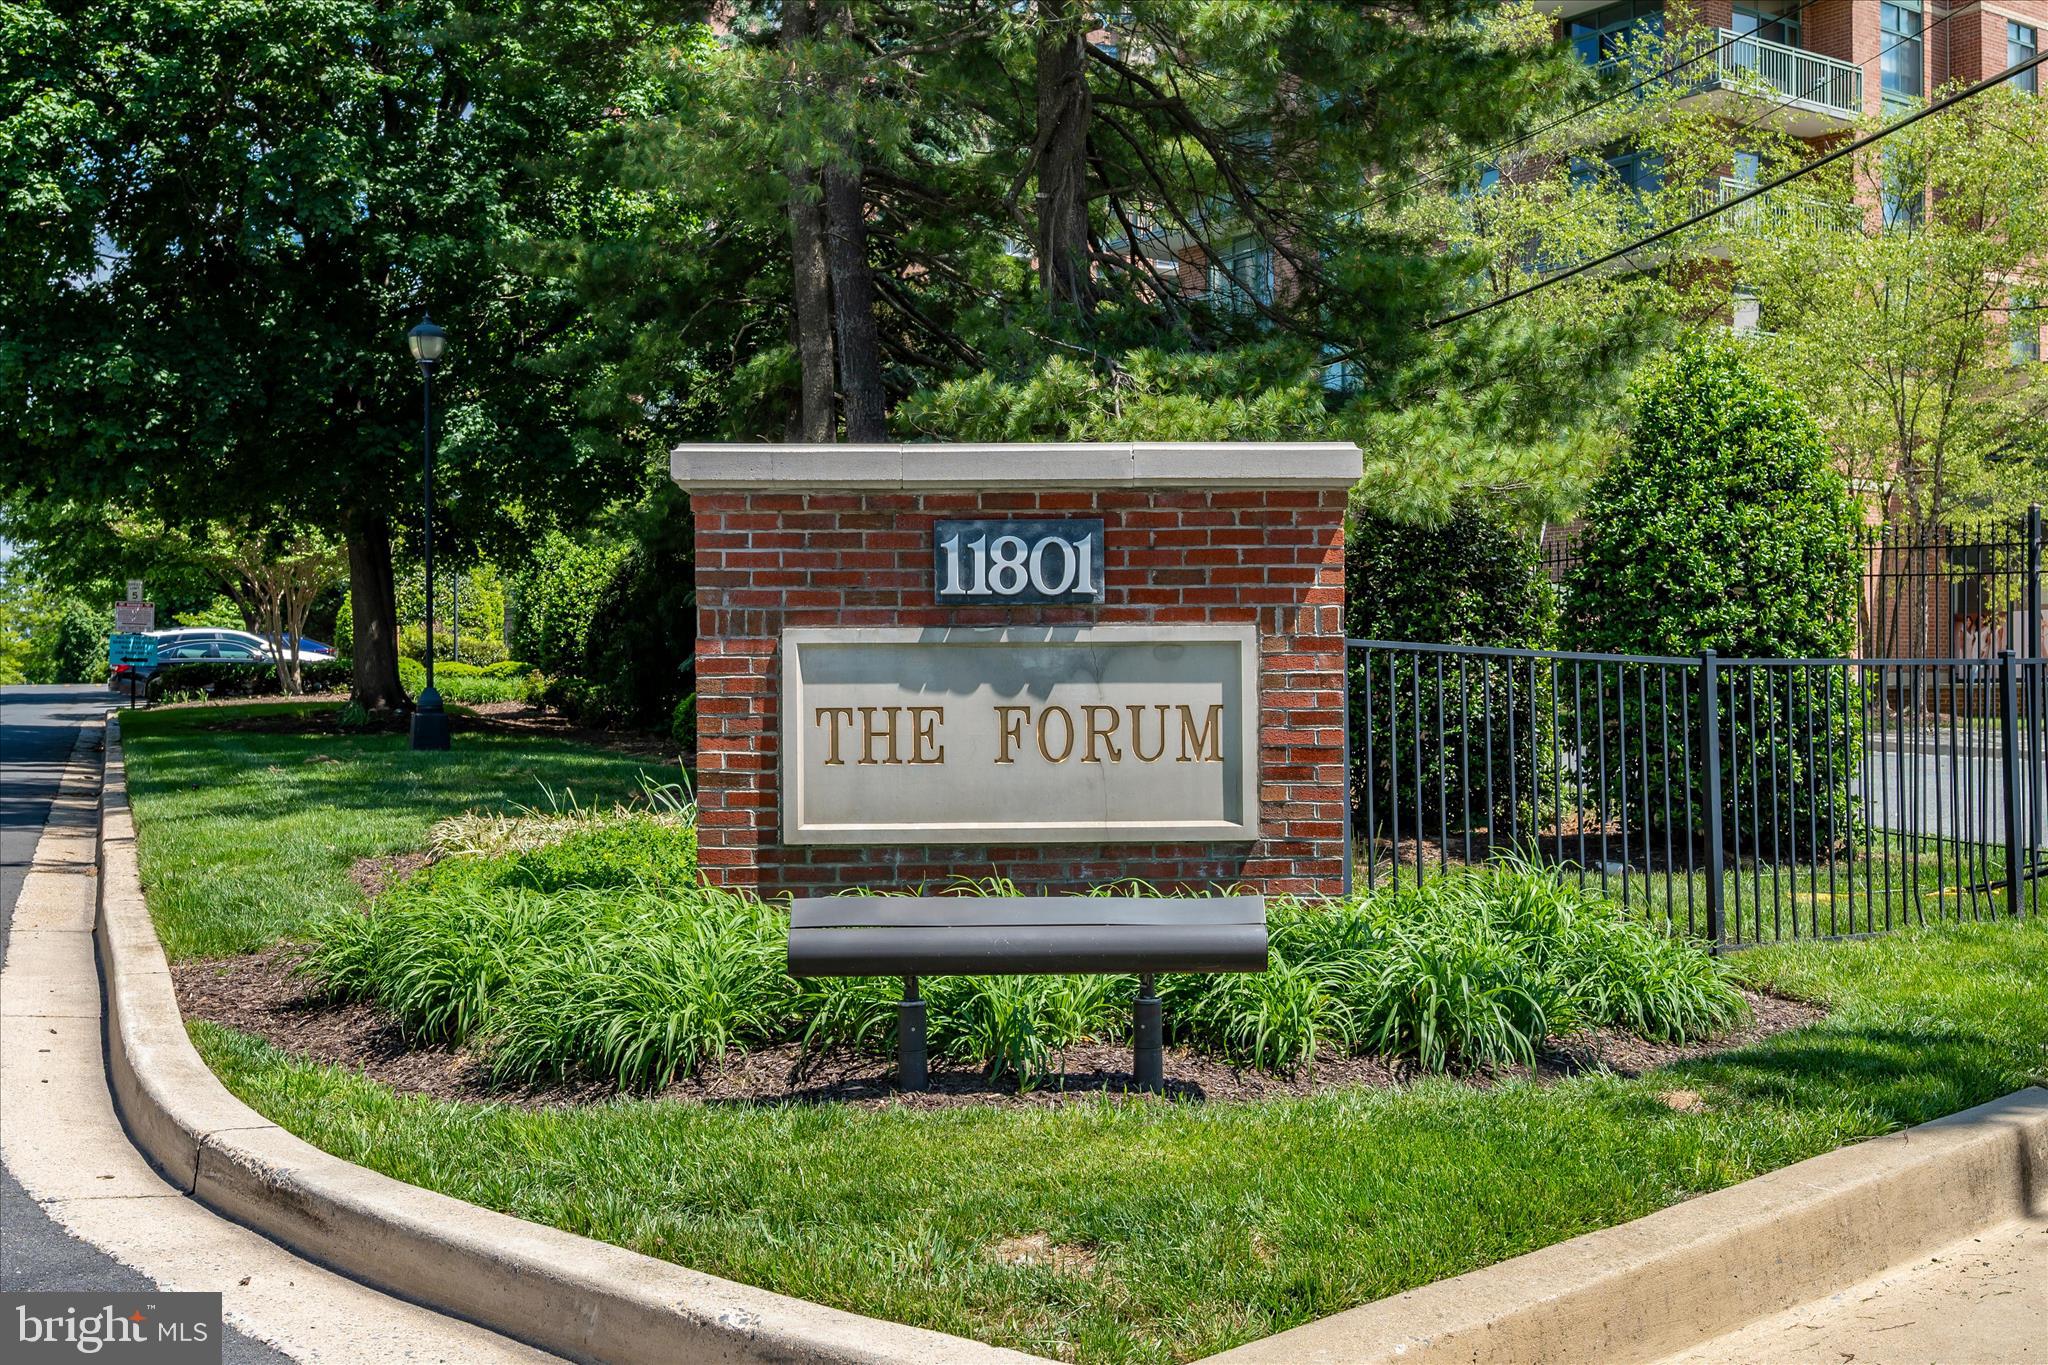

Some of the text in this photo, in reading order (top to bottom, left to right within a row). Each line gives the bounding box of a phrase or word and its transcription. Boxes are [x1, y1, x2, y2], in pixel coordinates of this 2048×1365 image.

[940, 532, 1098, 596] 11801
[815, 704, 1224, 766] THE FORUM
